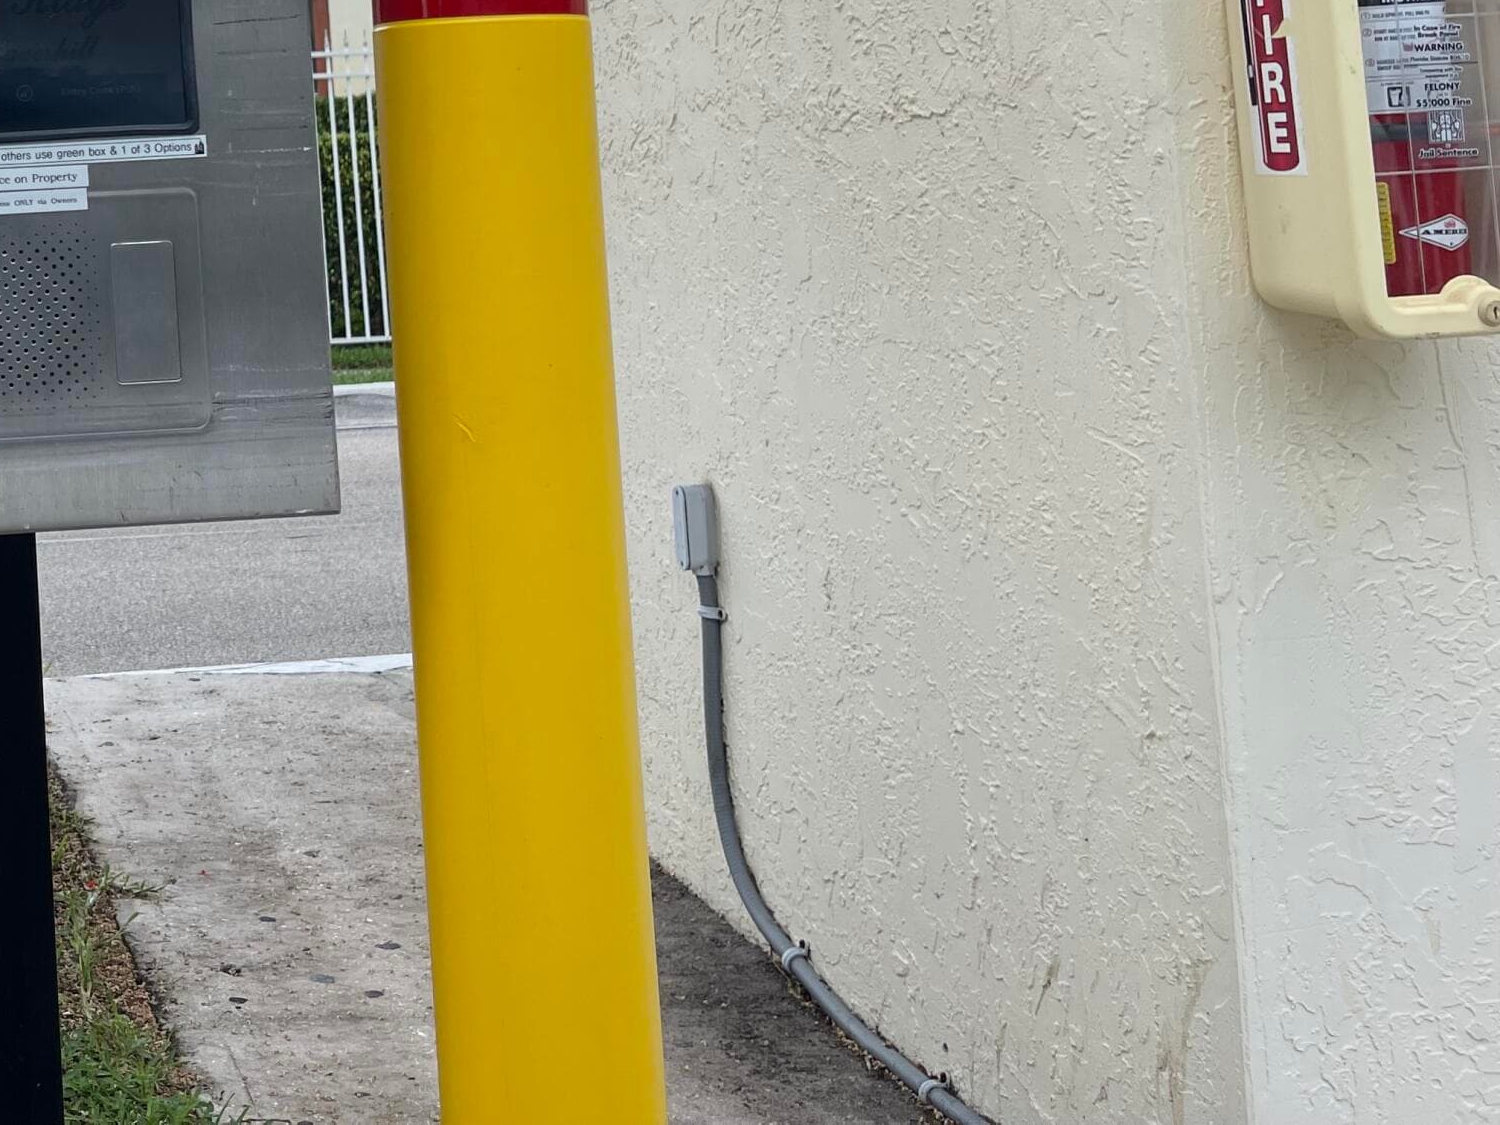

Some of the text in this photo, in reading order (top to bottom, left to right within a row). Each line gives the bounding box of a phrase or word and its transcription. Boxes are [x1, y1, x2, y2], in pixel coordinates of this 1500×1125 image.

[1414, 42, 1463, 52] WARNING
[1424, 82, 1460, 91] FELONY
[1416, 98, 1471, 108] $5,000 Fine
[1, 150, 31, 162] others
[35, 151, 53, 160] use
[56, 148, 85, 160] green
[88, 146, 106, 157] box
[110, 145, 117, 155] &
[132, 144, 141, 154] of
[144, 144, 151, 153] 3
[154, 141, 192, 154] Options
[1419, 147, 1478, 158] Jail Sentence
[14, 176, 28, 184] on
[32, 173, 78, 184] Property
[14, 199, 34, 207] ONLY
[50, 197, 78, 205] Owners
